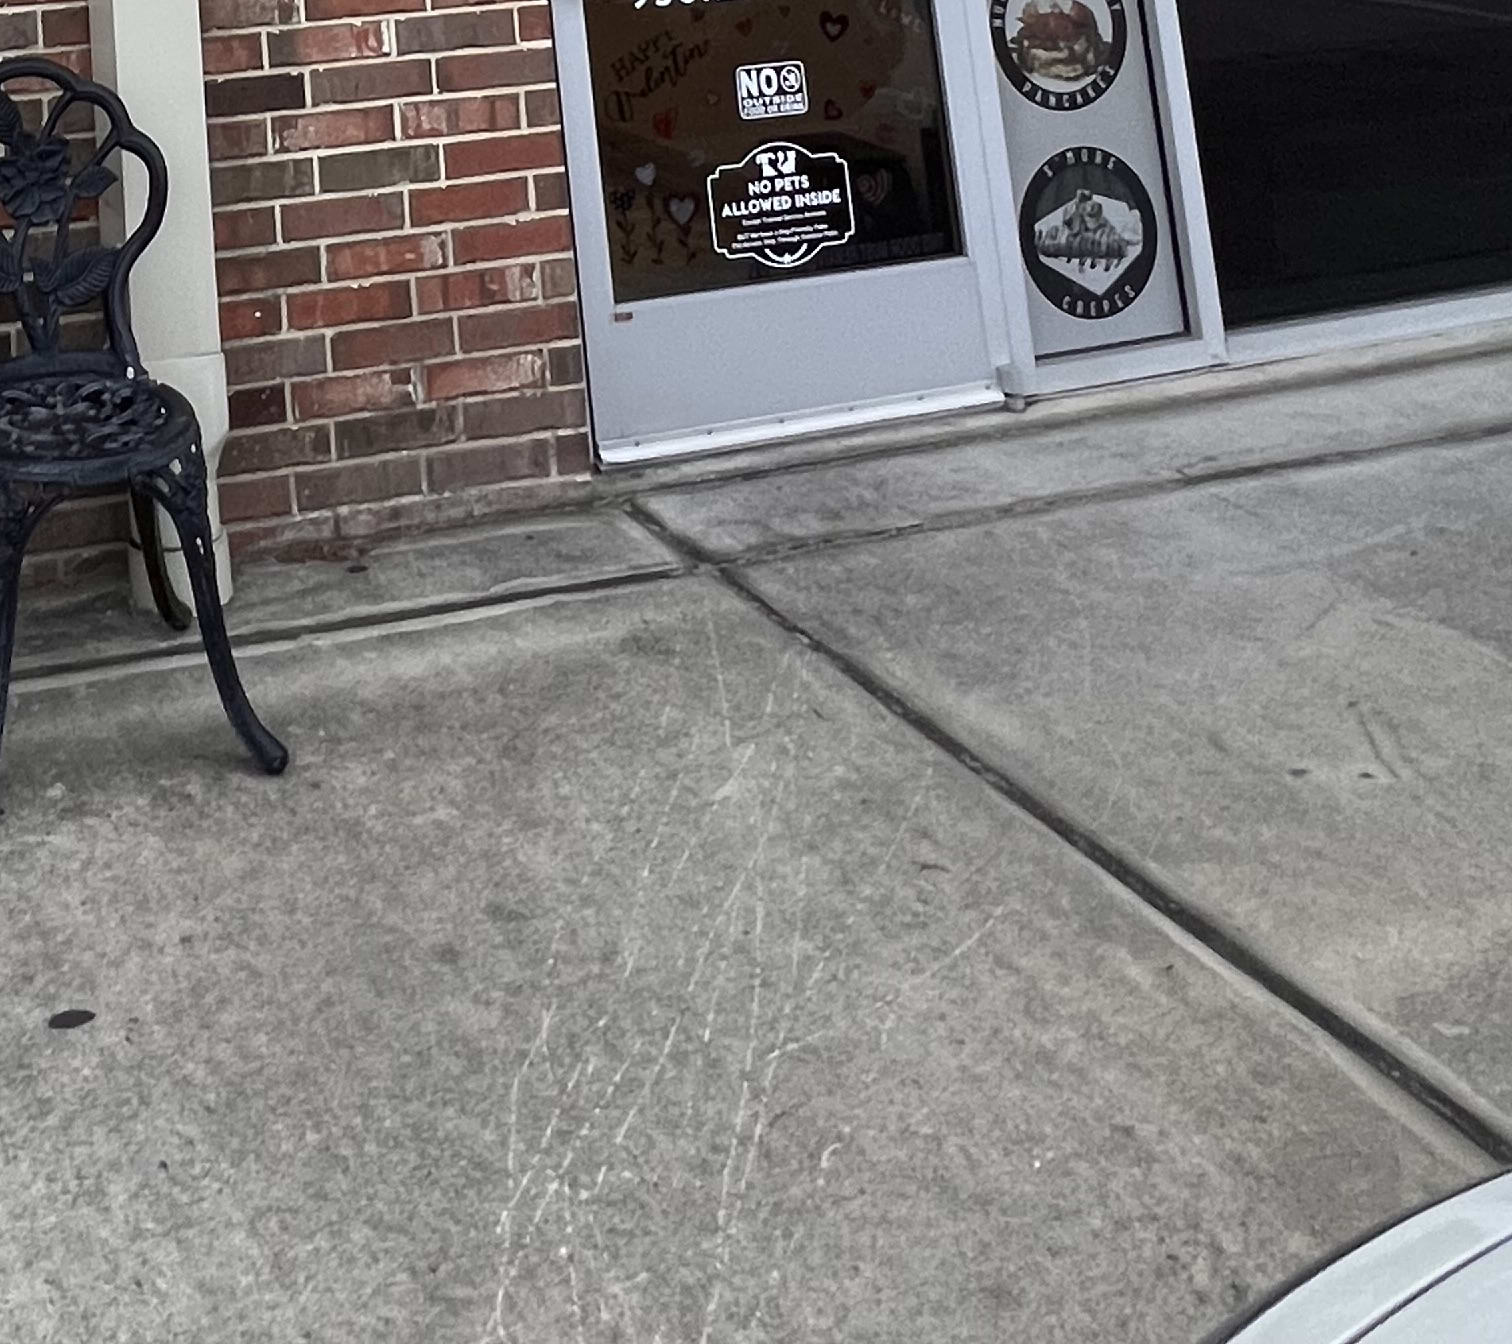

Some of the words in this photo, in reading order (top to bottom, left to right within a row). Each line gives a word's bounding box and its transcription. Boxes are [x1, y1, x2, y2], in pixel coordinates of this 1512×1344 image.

[740, 68, 778, 97] NO
[1022, 64, 1115, 108] PANCAKES
[742, 93, 803, 107] OUTSIDE
[748, 180, 772, 196] NO
[775, 175, 810, 192] PETS
[721, 196, 792, 217] ALLOWED
[795, 189, 841, 207] INSIDE
[1062, 284, 1136, 316] CREPES
